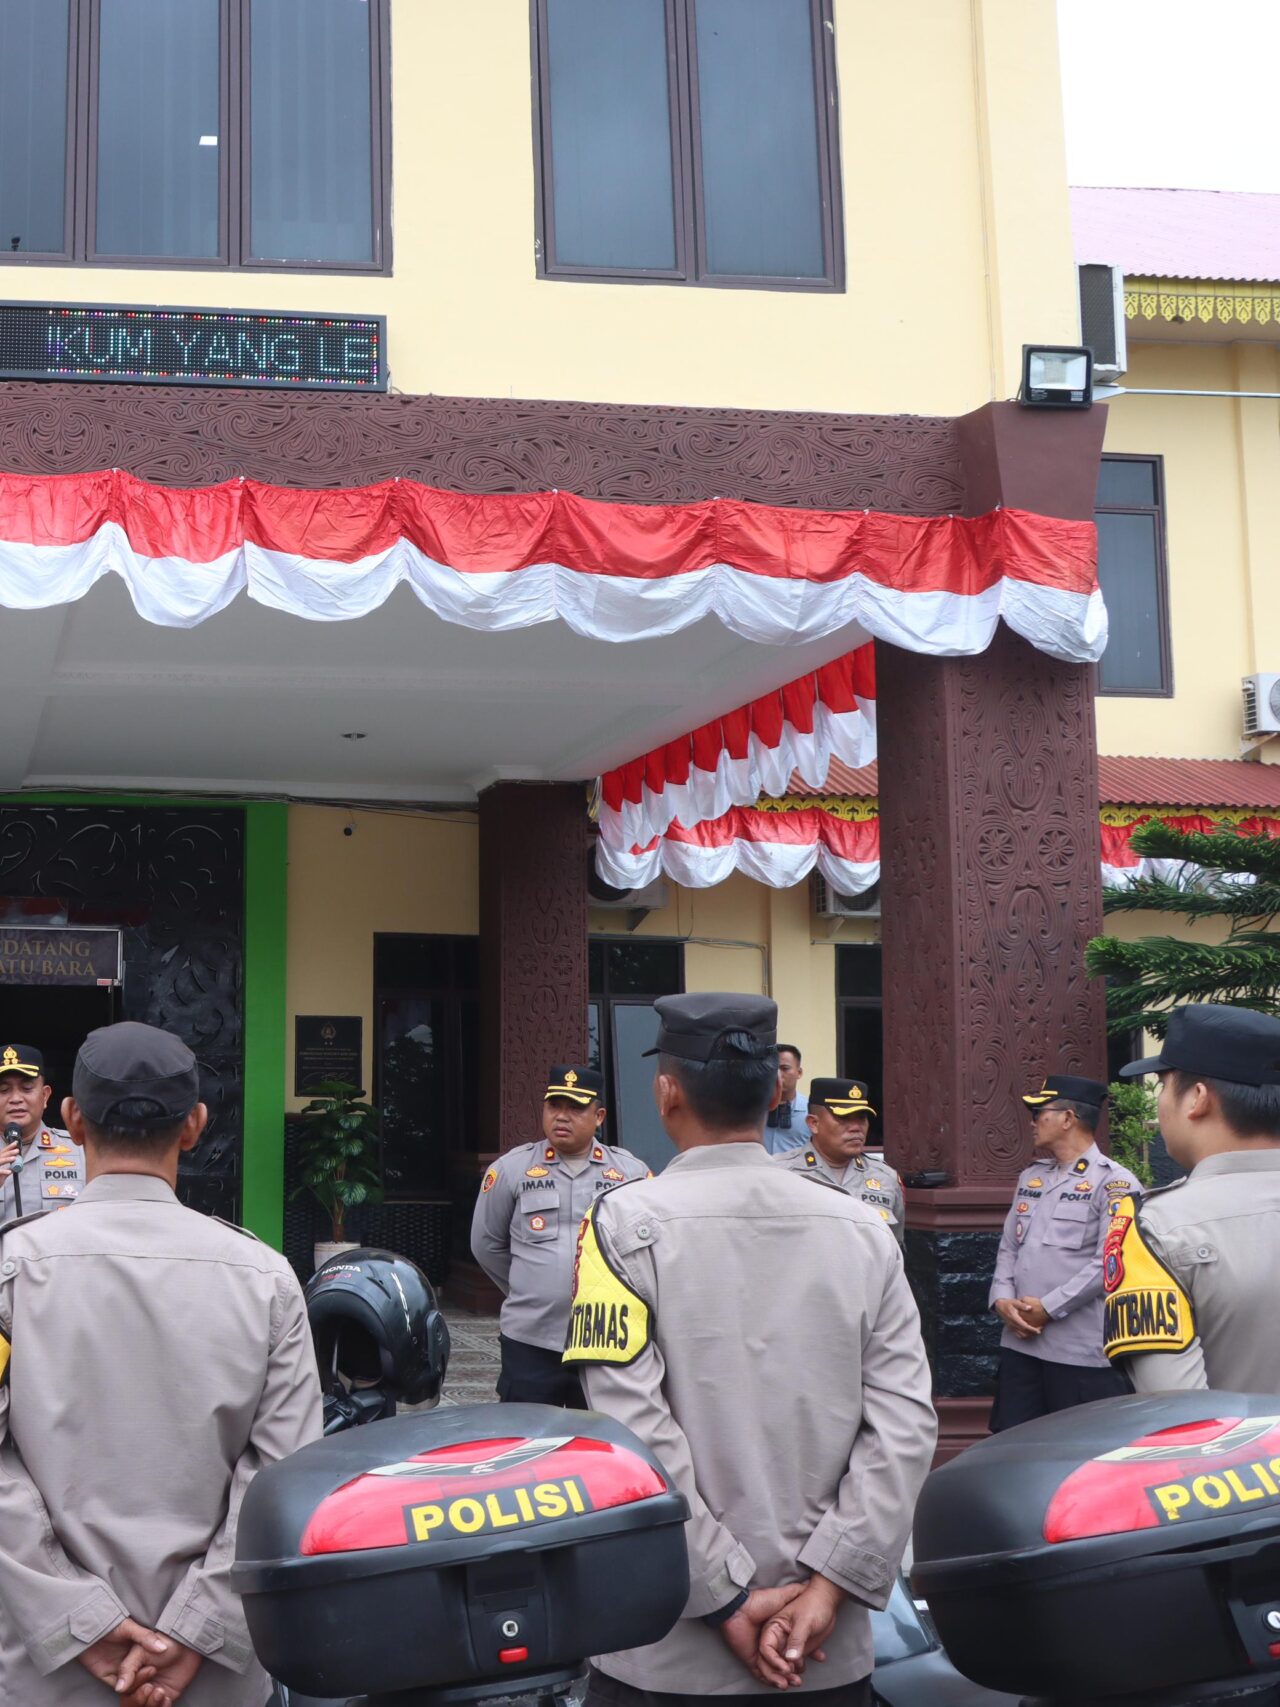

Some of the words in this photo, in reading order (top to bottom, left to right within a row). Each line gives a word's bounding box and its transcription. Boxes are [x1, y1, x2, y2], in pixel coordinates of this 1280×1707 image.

[172, 329, 300, 370] YANG
[319, 336, 372, 374] LE
[3, 938, 91, 957] DATANG
[41, 960, 97, 977] BARA
[45, 1170, 78, 1180] POLRI
[522, 1179, 556, 1191] IMAM
[861, 1193, 890, 1206] POLRI
[1060, 1192, 1093, 1202] POLRI
[321, 1264, 362, 1276] HONDA
[410, 1479, 585, 1542] POLISI
